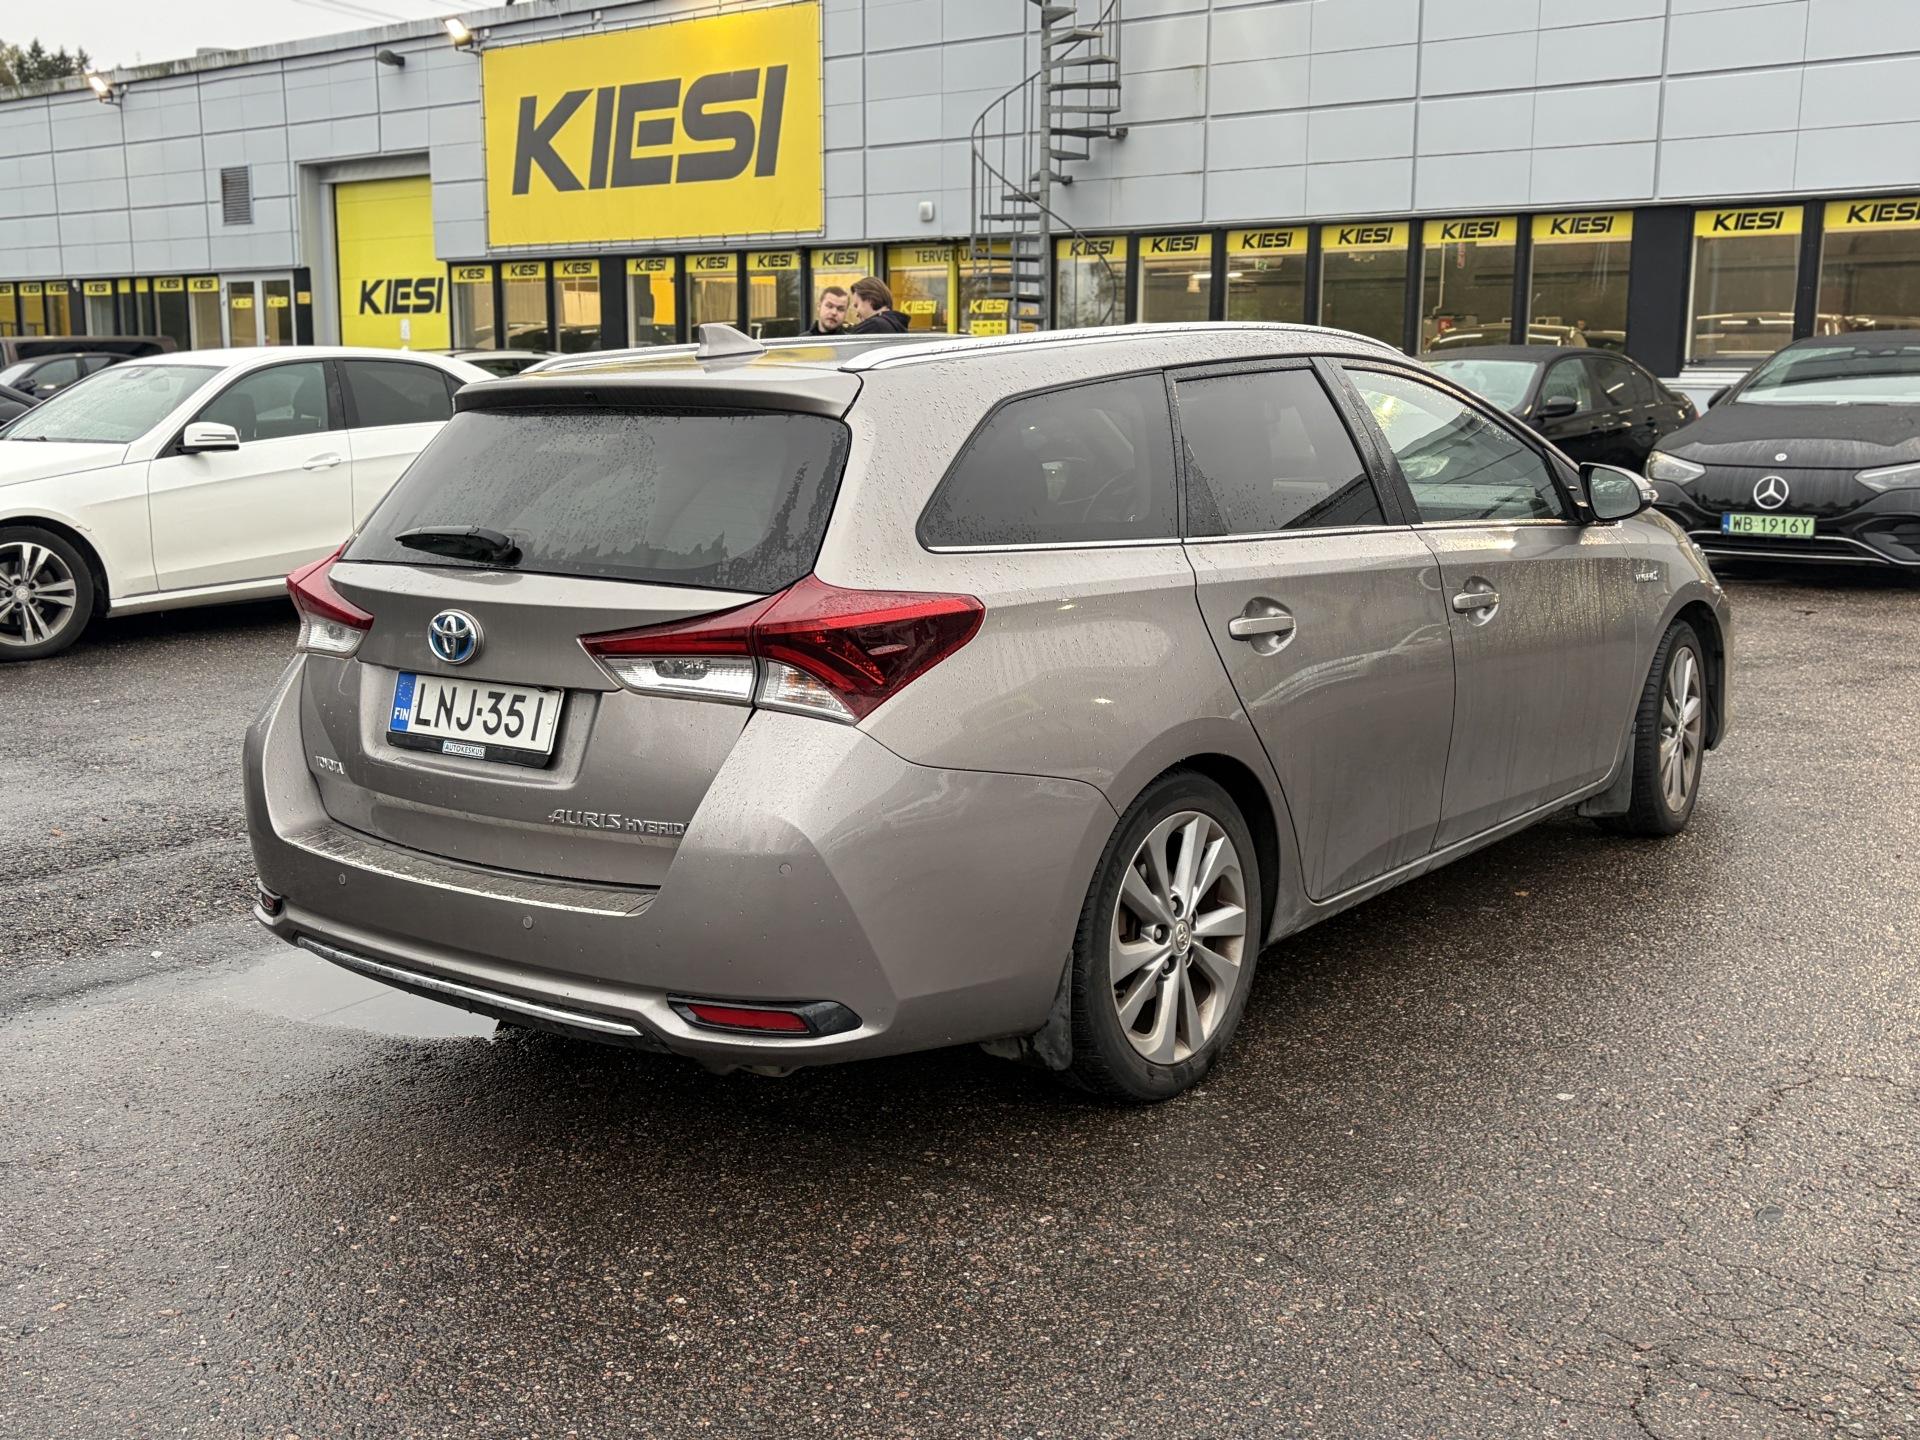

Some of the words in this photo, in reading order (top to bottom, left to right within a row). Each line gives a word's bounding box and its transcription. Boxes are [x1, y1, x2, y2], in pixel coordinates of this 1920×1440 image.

[512, 64, 788, 195] KIESI
[1550, 216, 1614, 235] KIESI
[1713, 211, 1784, 231] KIESI
[1338, 227, 1393, 245] KIESI
[1440, 221, 1499, 240] KIESI
[1070, 240, 1115, 256] KIESI
[1151, 236, 1198, 253] KIESI
[1242, 231, 1293, 249] KIESI
[635, 258, 666, 272] KIESI
[695, 256, 729, 269] KIESI
[757, 254, 791, 268] KIESI
[822, 251, 858, 266] KIESI
[458, 268, 485, 280] KIESI
[510, 263, 538, 277] KIESI
[562, 262, 592, 275] KIESI
[359, 277, 444, 315] KIESI
[900, 300, 937, 314] KIESI
[969, 299, 1008, 314] KIESI
[1732, 516, 1753, 531] WB
[1760, 517, 1810, 534] 1916Y
[393, 707, 410, 721] FIN
[414, 683, 544, 742] LNJ-351
[444, 742, 484, 757] AUTOKESKUS
[548, 808, 622, 829] AURIS
[624, 817, 685, 836] HYBRID
